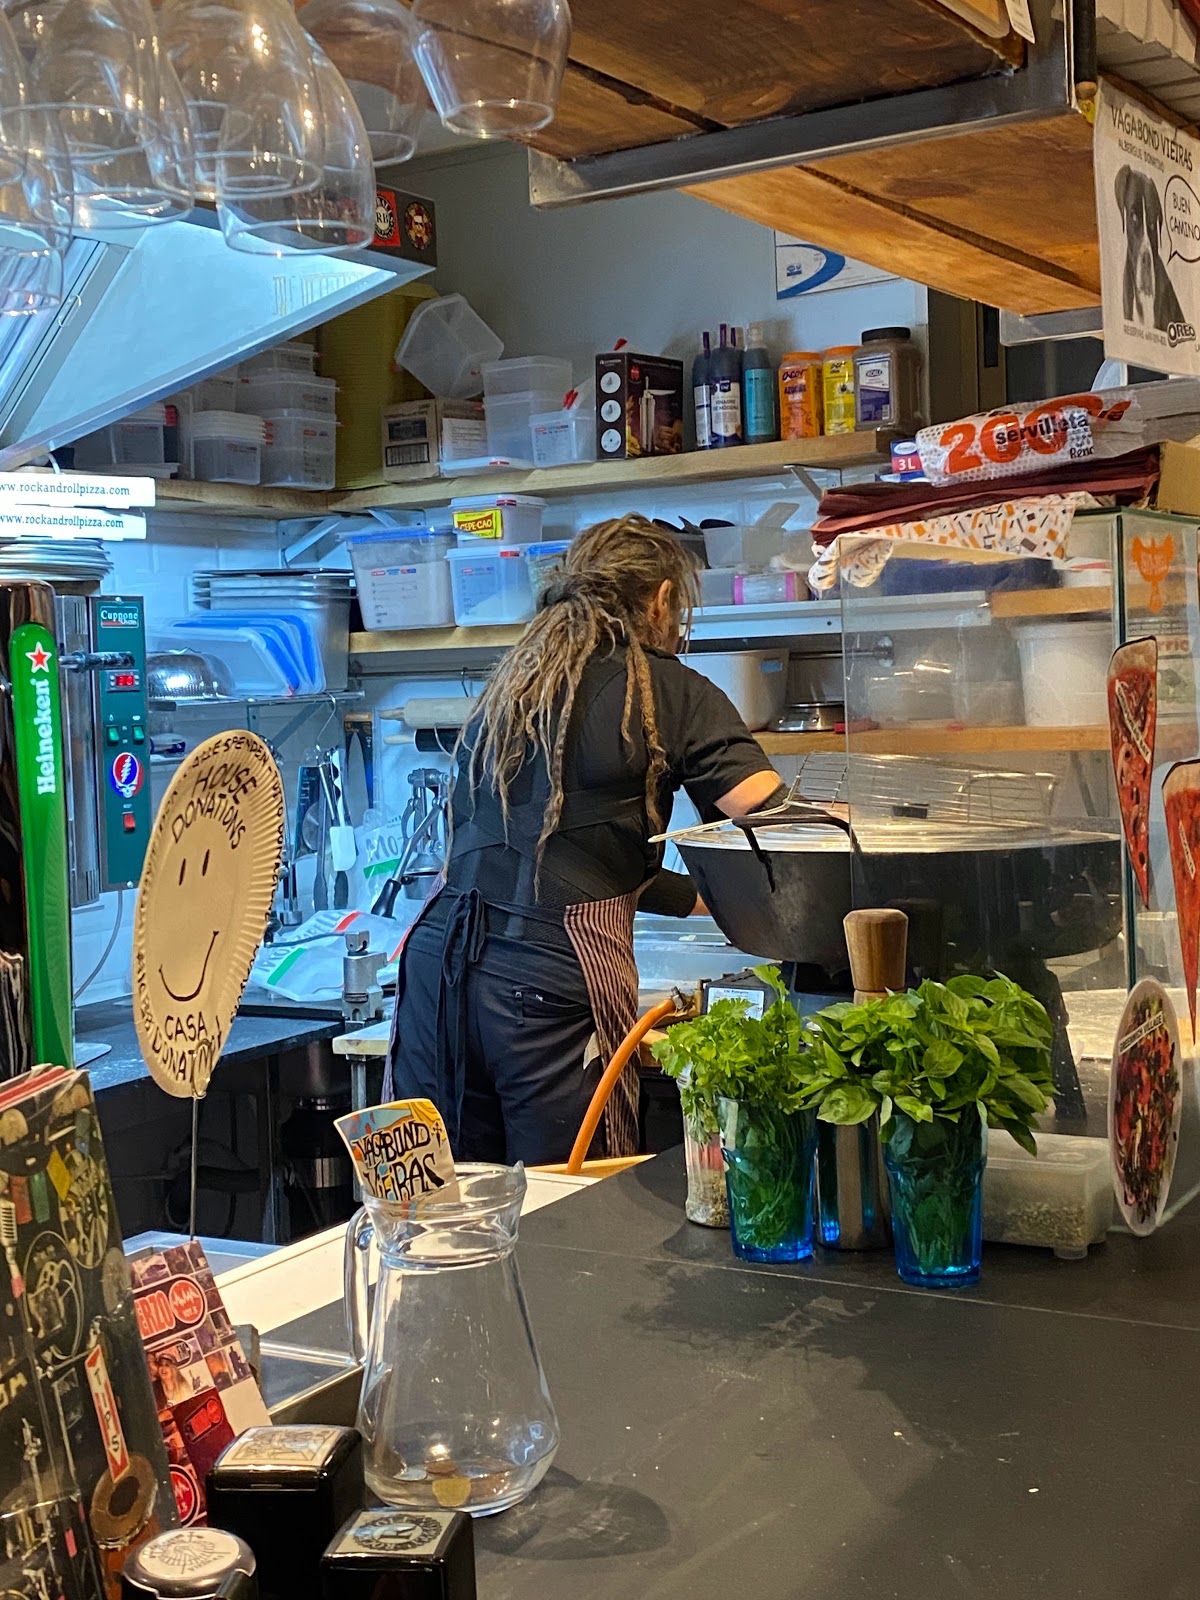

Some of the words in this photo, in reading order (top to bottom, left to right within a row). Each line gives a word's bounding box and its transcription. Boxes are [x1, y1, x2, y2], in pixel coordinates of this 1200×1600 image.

[1111, 106, 1160, 151] VAGABOND
[1161, 134, 1193, 172] VIEIRAS
[1172, 192, 1191, 215] BUEN
[1170, 216, 1200, 241] CAMINO
[1168, 323, 1195, 342] OREO
[100, 609, 139, 622] Cuppone
[33, 678, 56, 795] Heineken
[191, 763, 257, 805] HOUSE
[171, 791, 247, 850] DONATIONS
[164, 1011, 208, 1042] CASA
[353, 1120, 432, 1167] VAGABOND
